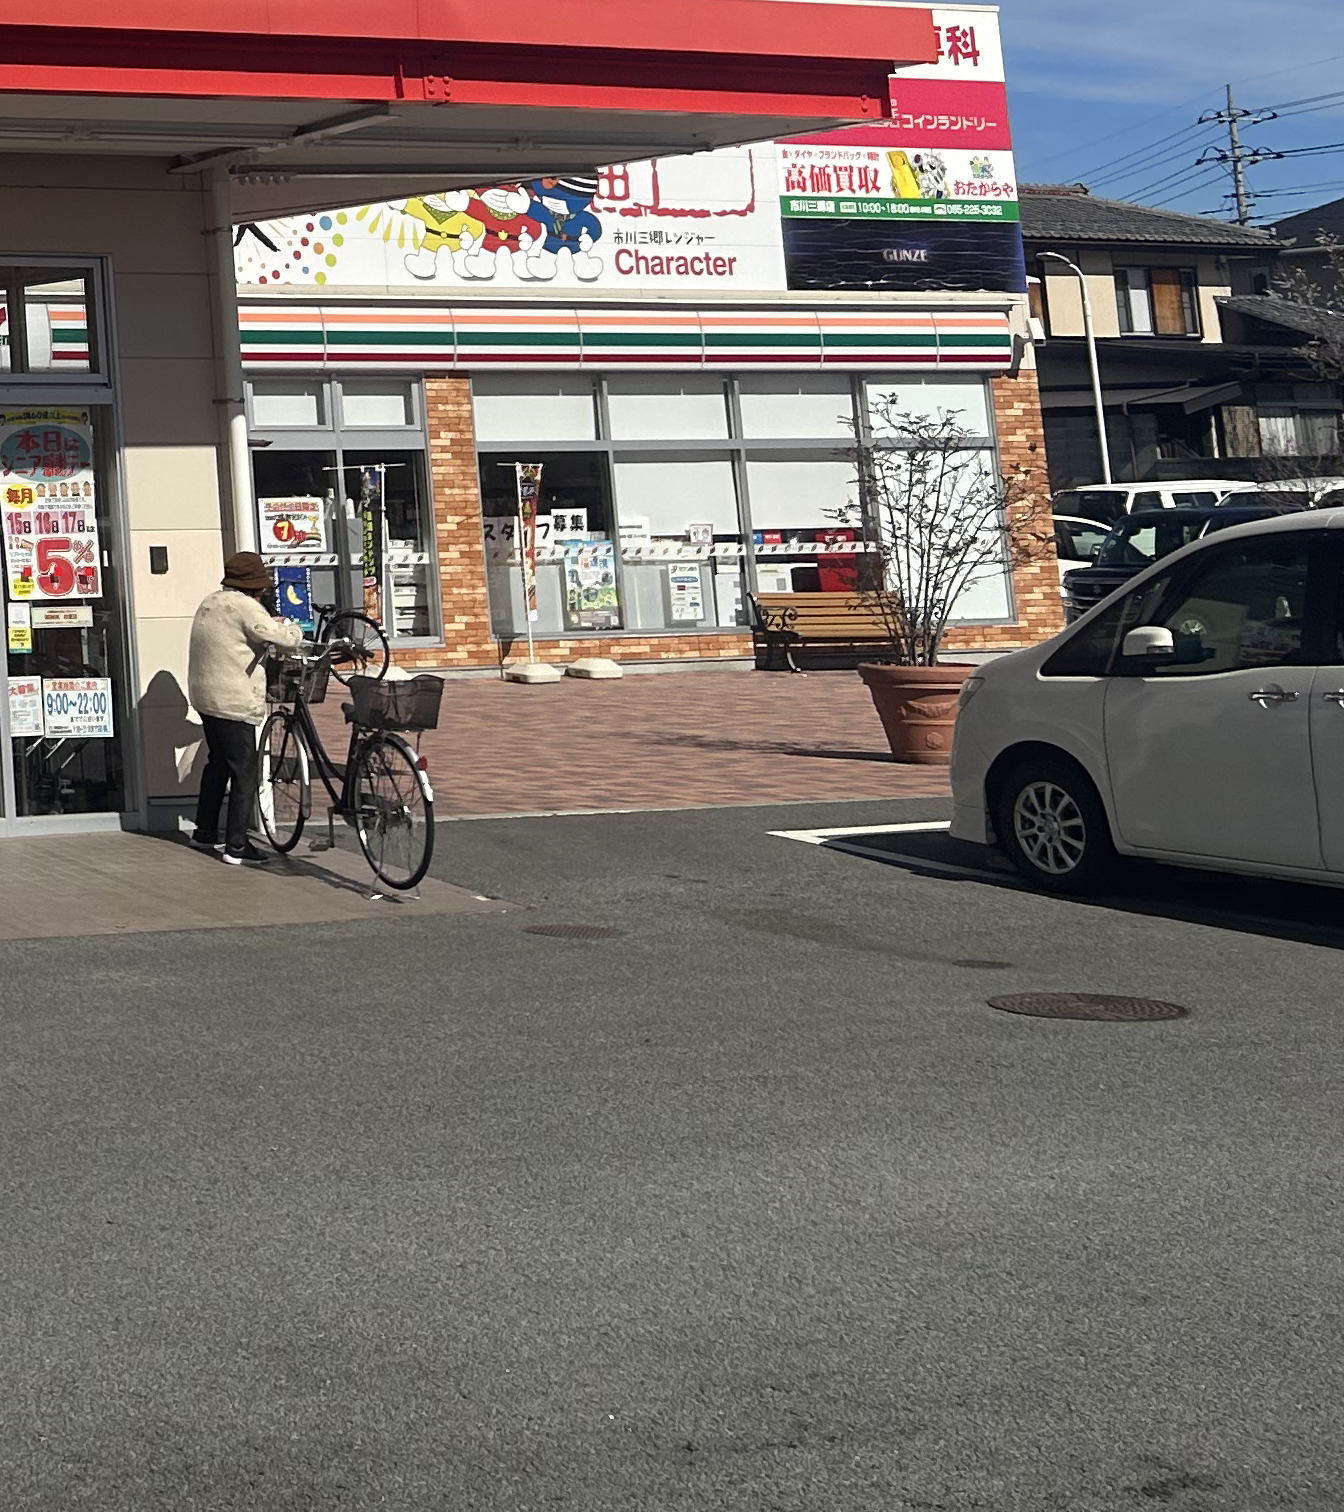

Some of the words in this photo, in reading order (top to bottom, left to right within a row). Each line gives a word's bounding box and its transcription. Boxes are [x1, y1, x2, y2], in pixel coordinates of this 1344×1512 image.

[785, 164, 881, 194] 高価買取
[954, 180, 1013, 197] おたからや
[613, 229, 715, 245] 市川三郷レンジャー
[615, 249, 737, 276] Character
[16, 429, 79, 453] 本日は
[6, 488, 33, 504] 毎月
